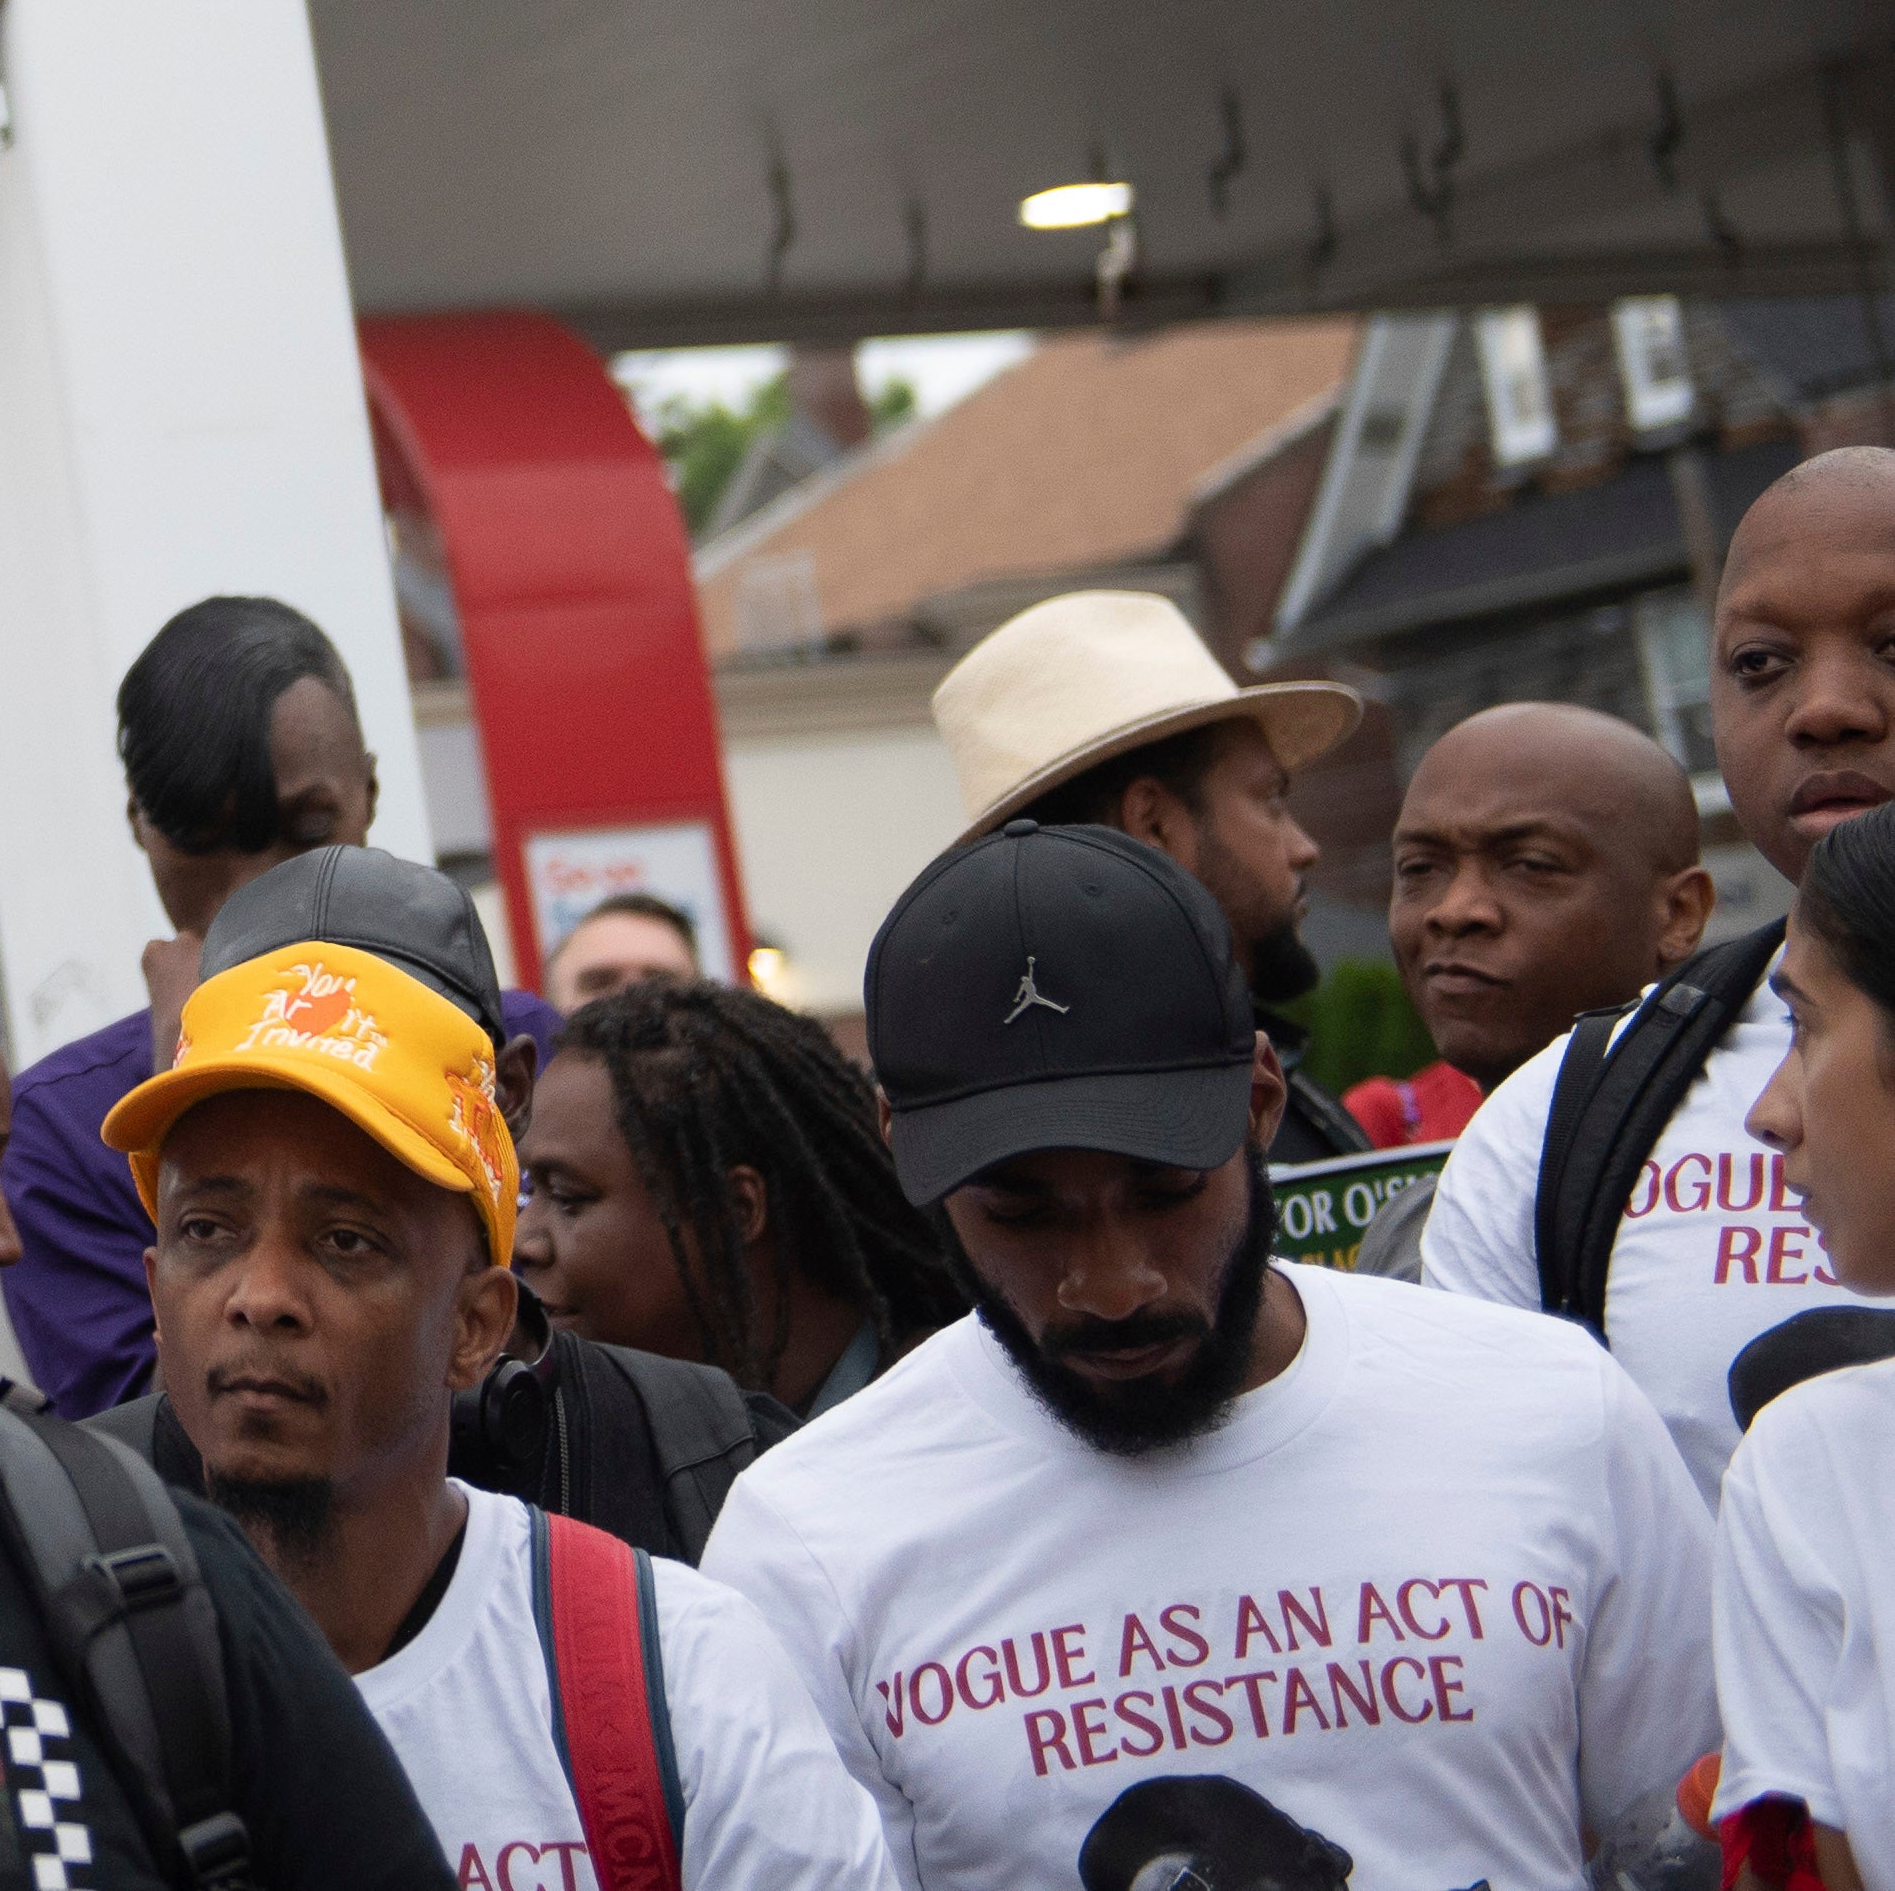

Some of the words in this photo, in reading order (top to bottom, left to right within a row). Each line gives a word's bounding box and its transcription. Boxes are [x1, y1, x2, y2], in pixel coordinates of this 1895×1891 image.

[1271, 1190, 1338, 1242] OR
[876, 1624, 1097, 1739] VOGUE
[1118, 1604, 1211, 1676] AS
[1234, 1586, 1333, 1659] AN
[1358, 1577, 1488, 1645] ACT
[1512, 1580, 1573, 1650] OF
[1023, 1654, 1475, 1778] RESISTANCE
[458, 1841, 589, 1891] ACT
